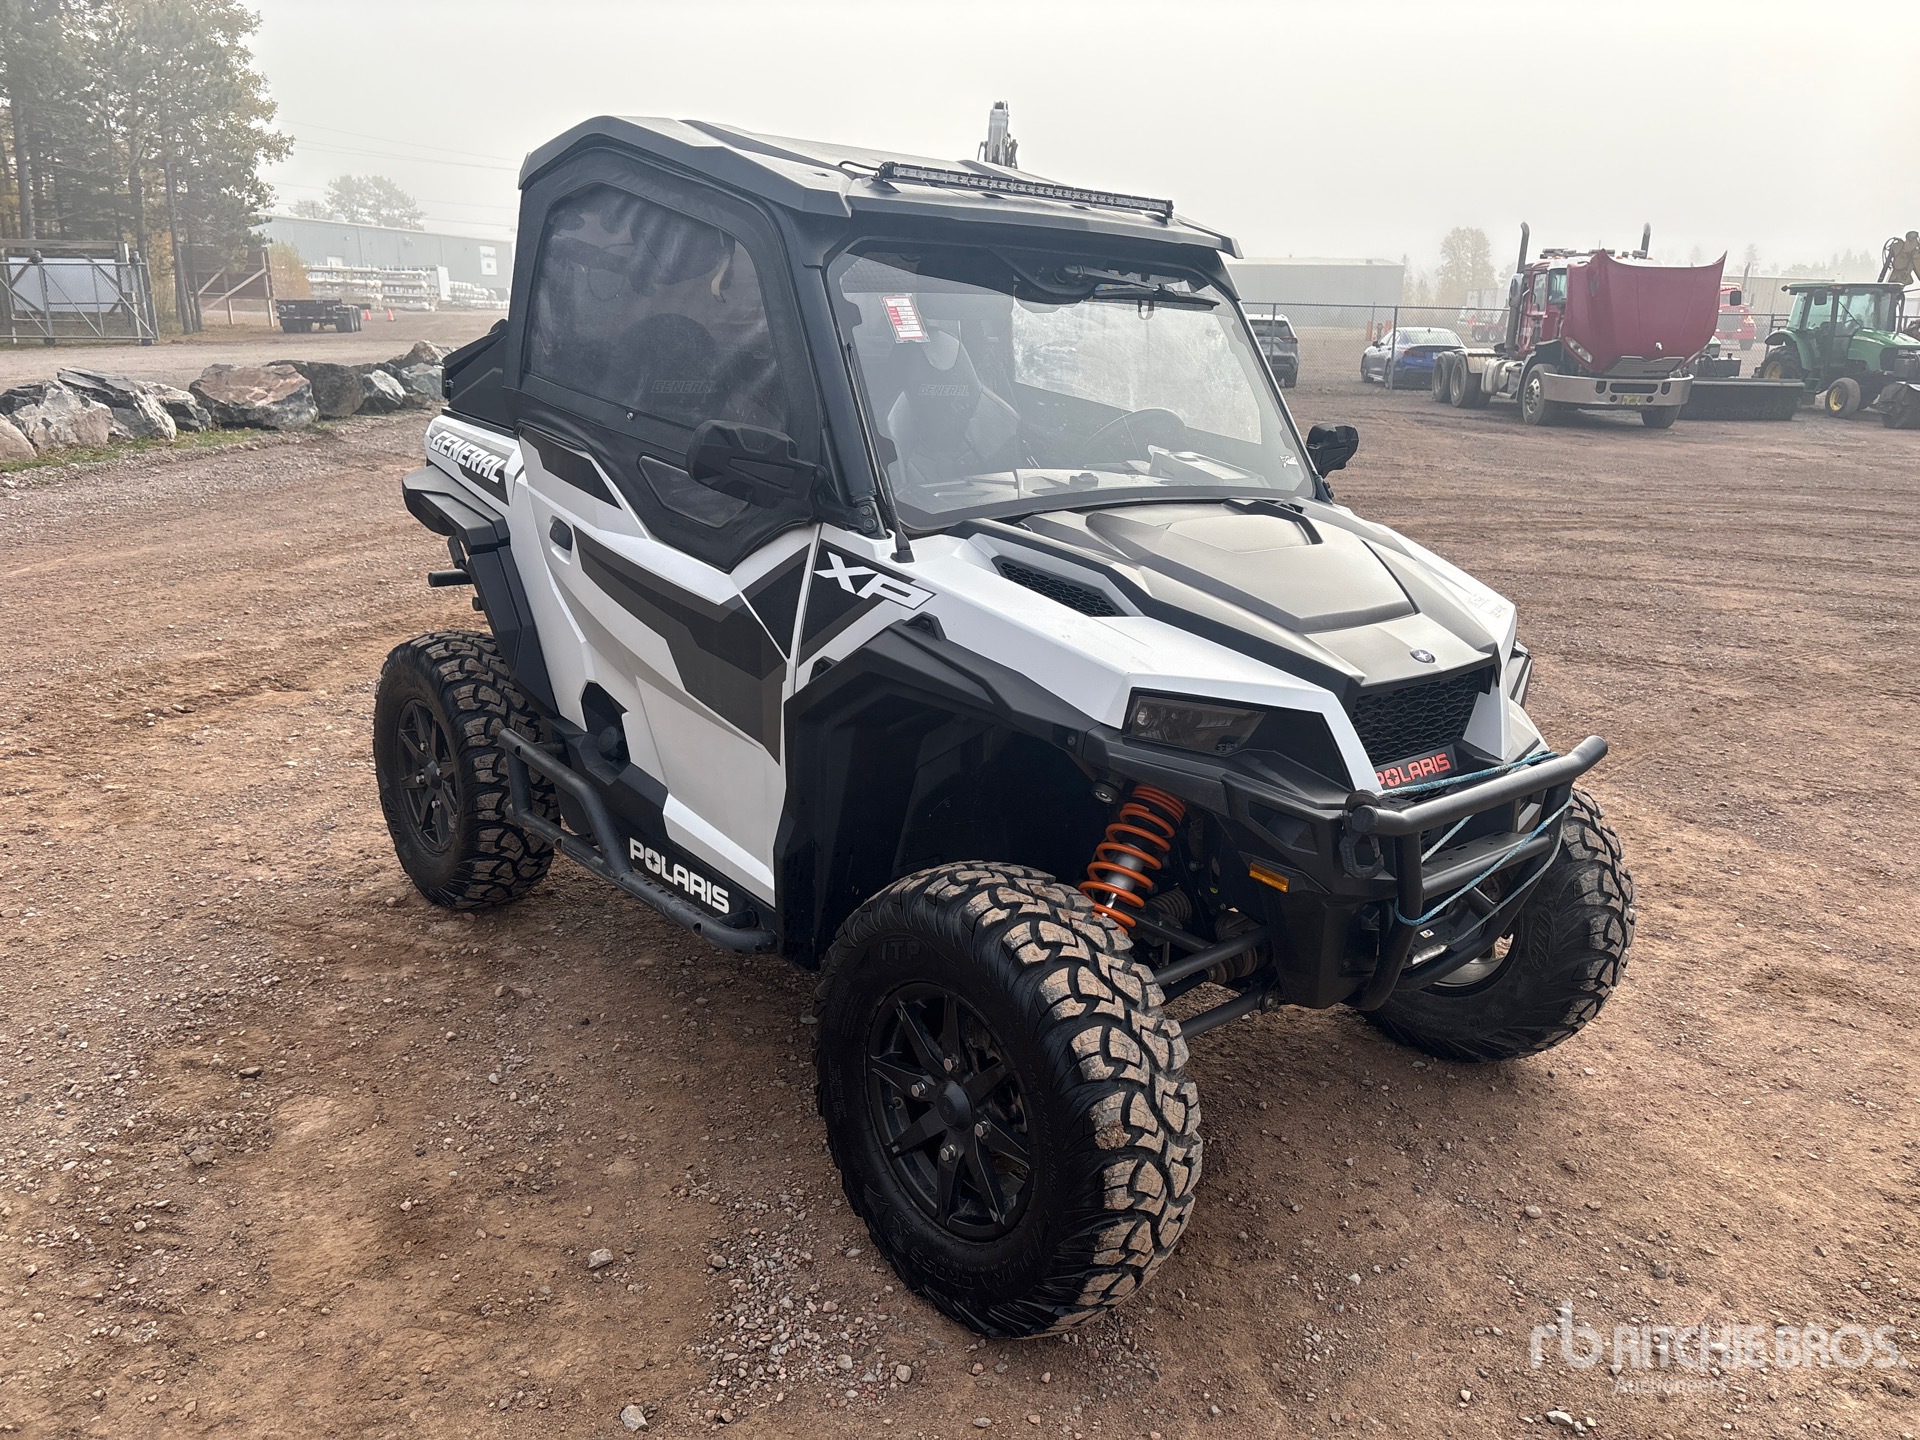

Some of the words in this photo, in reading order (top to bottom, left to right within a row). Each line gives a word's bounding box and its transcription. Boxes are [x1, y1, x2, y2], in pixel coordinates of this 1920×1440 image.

[918, 383, 970, 397] GENERAL
[429, 430, 507, 484] GENERAL
[812, 551, 937, 611] XP
[1375, 752, 1452, 787] POLARIS
[629, 837, 730, 915] POLARIS
[880, 938, 921, 963] ITP
